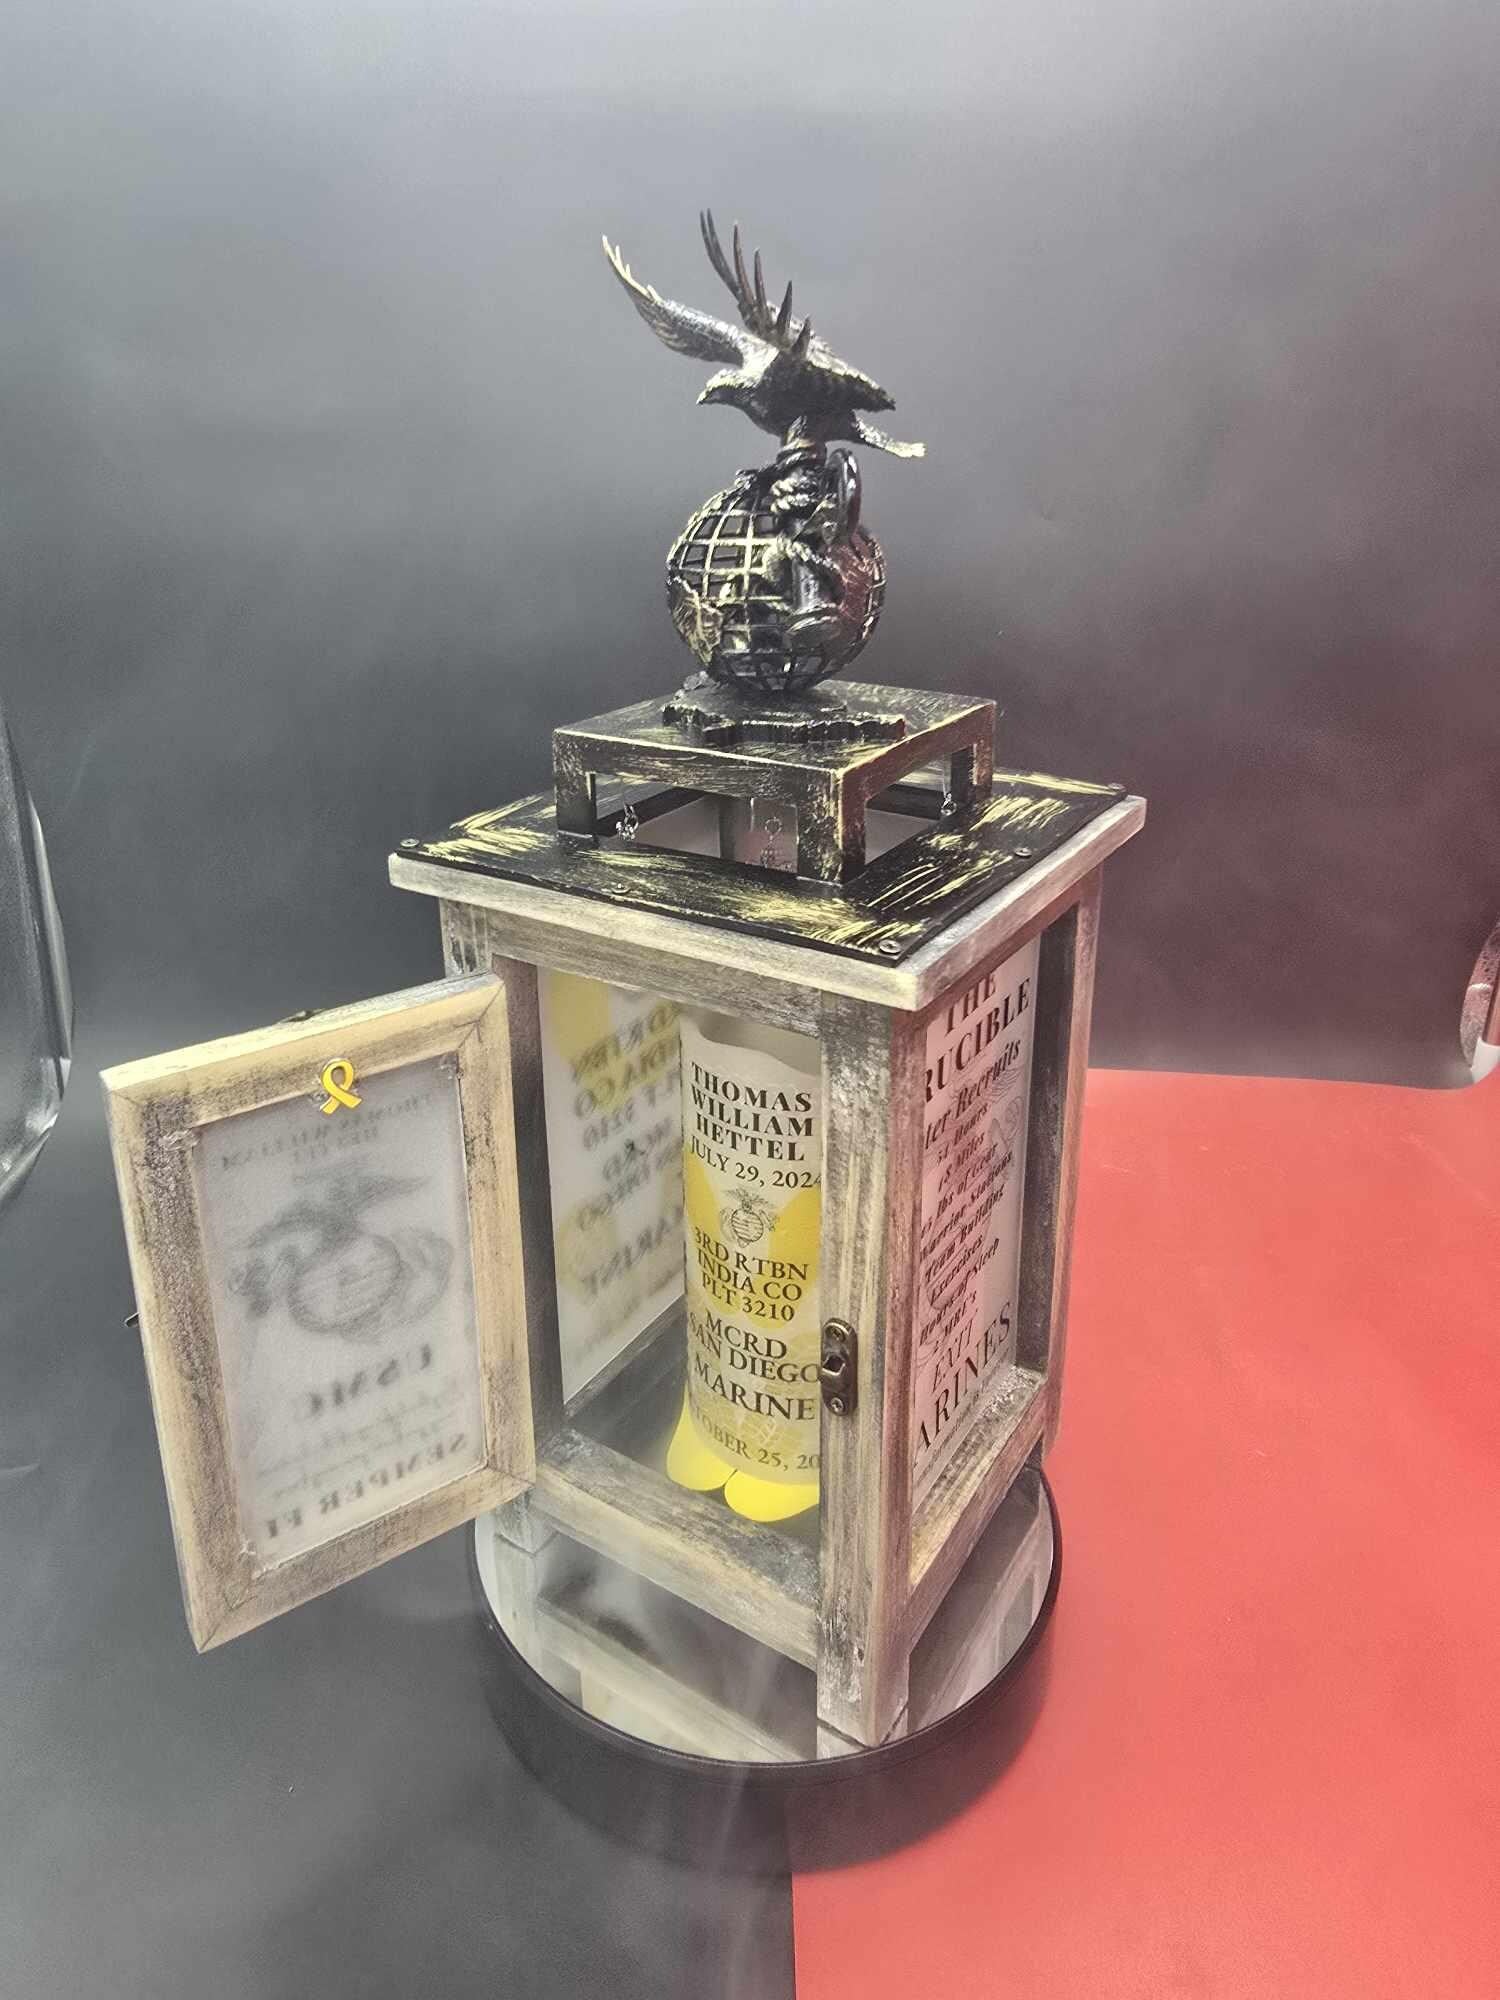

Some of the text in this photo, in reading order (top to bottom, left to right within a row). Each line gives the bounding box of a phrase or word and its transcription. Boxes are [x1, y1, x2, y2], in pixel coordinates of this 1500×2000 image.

[944, 972, 996, 1038] THE
[924, 976, 1031, 1103] RUCIBLE
[690, 1082, 813, 1137] WILLIAM
[691, 1061, 812, 1112] THOMAS
[925, 1039, 1021, 1150] ter Recruits
[696, 1112, 805, 1161] HETTEL
[953, 1102, 988, 1146] Hours
[955, 1131, 985, 1170] Miles
[690, 1134, 729, 1172] JULY
[735, 1161, 765, 1187] 29,
[936, 1191, 955, 1219] lbs
[957, 1167, 971, 1195] of
[971, 1142, 999, 1179] Gear
[969, 1150, 1013, 1203] Stations
[694, 1225, 810, 1281] 3RD RTBN
[925, 1183, 1006, 1283] Team Building
[697, 1246, 802, 1302] INDIA CO
[701, 1270, 795, 1322] PLT 3210
[919, 1296, 954, 1346] Hours
[971, 1237, 1000, 1277] Sleep
[930, 1233, 984, 1307] Exercises
[689, 1311, 722, 1359] SAN
[727, 1345, 821, 1384] DIEGO
[705, 1307, 788, 1360] MCRD
[932, 1307, 978, 1394] EXIT
[694, 1350, 816, 1421] MARINE
[914, 1301, 1011, 1450] ARINES
[757, 1447, 789, 1472] 25,
